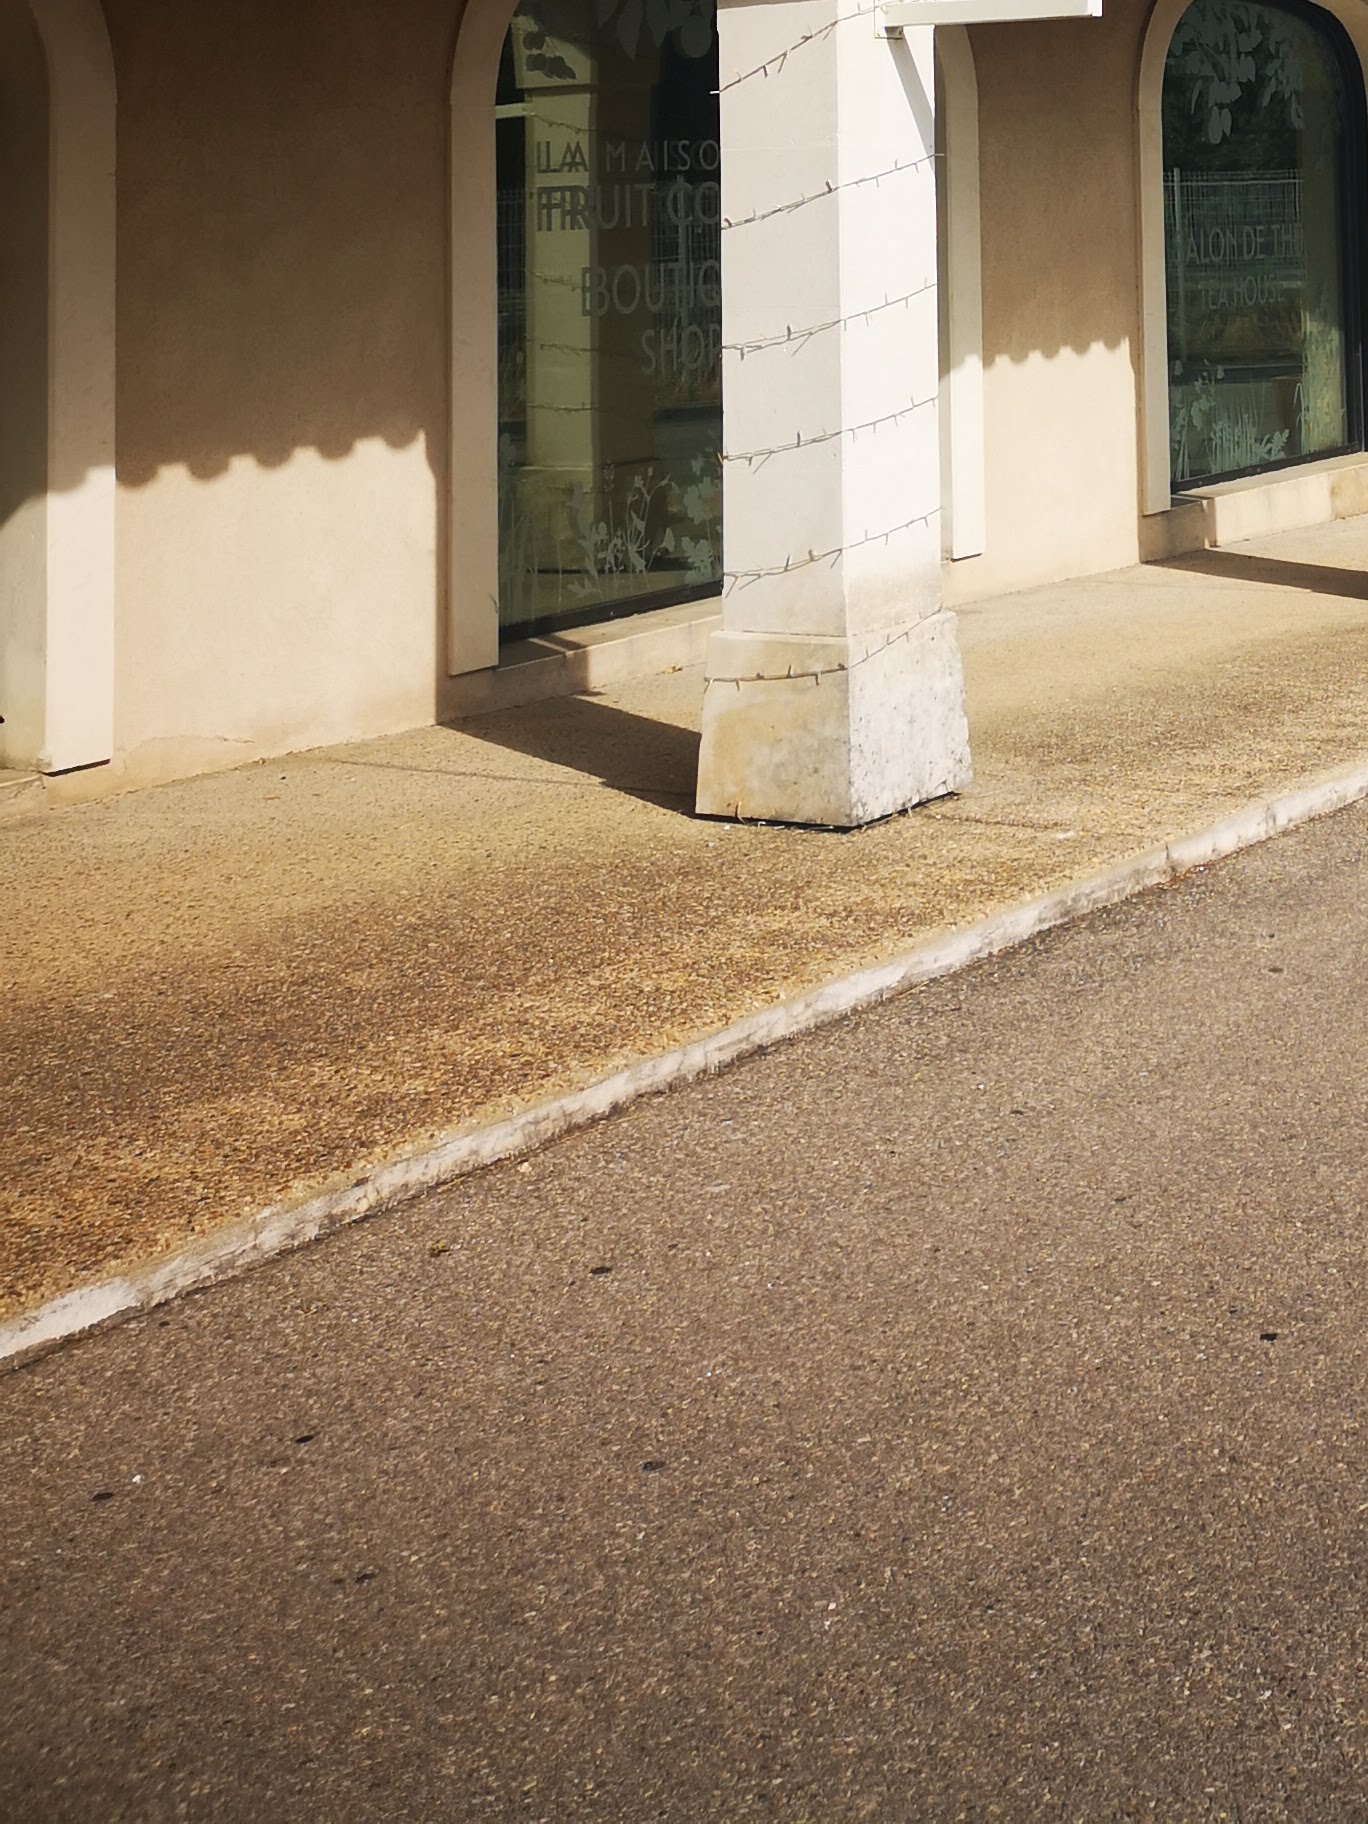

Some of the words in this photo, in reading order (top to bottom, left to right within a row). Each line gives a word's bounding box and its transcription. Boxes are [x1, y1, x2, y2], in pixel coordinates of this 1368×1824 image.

[537, 141, 589, 173] LA
[537, 183, 656, 232] FRUIT
[1243, 226, 1266, 261] DE
